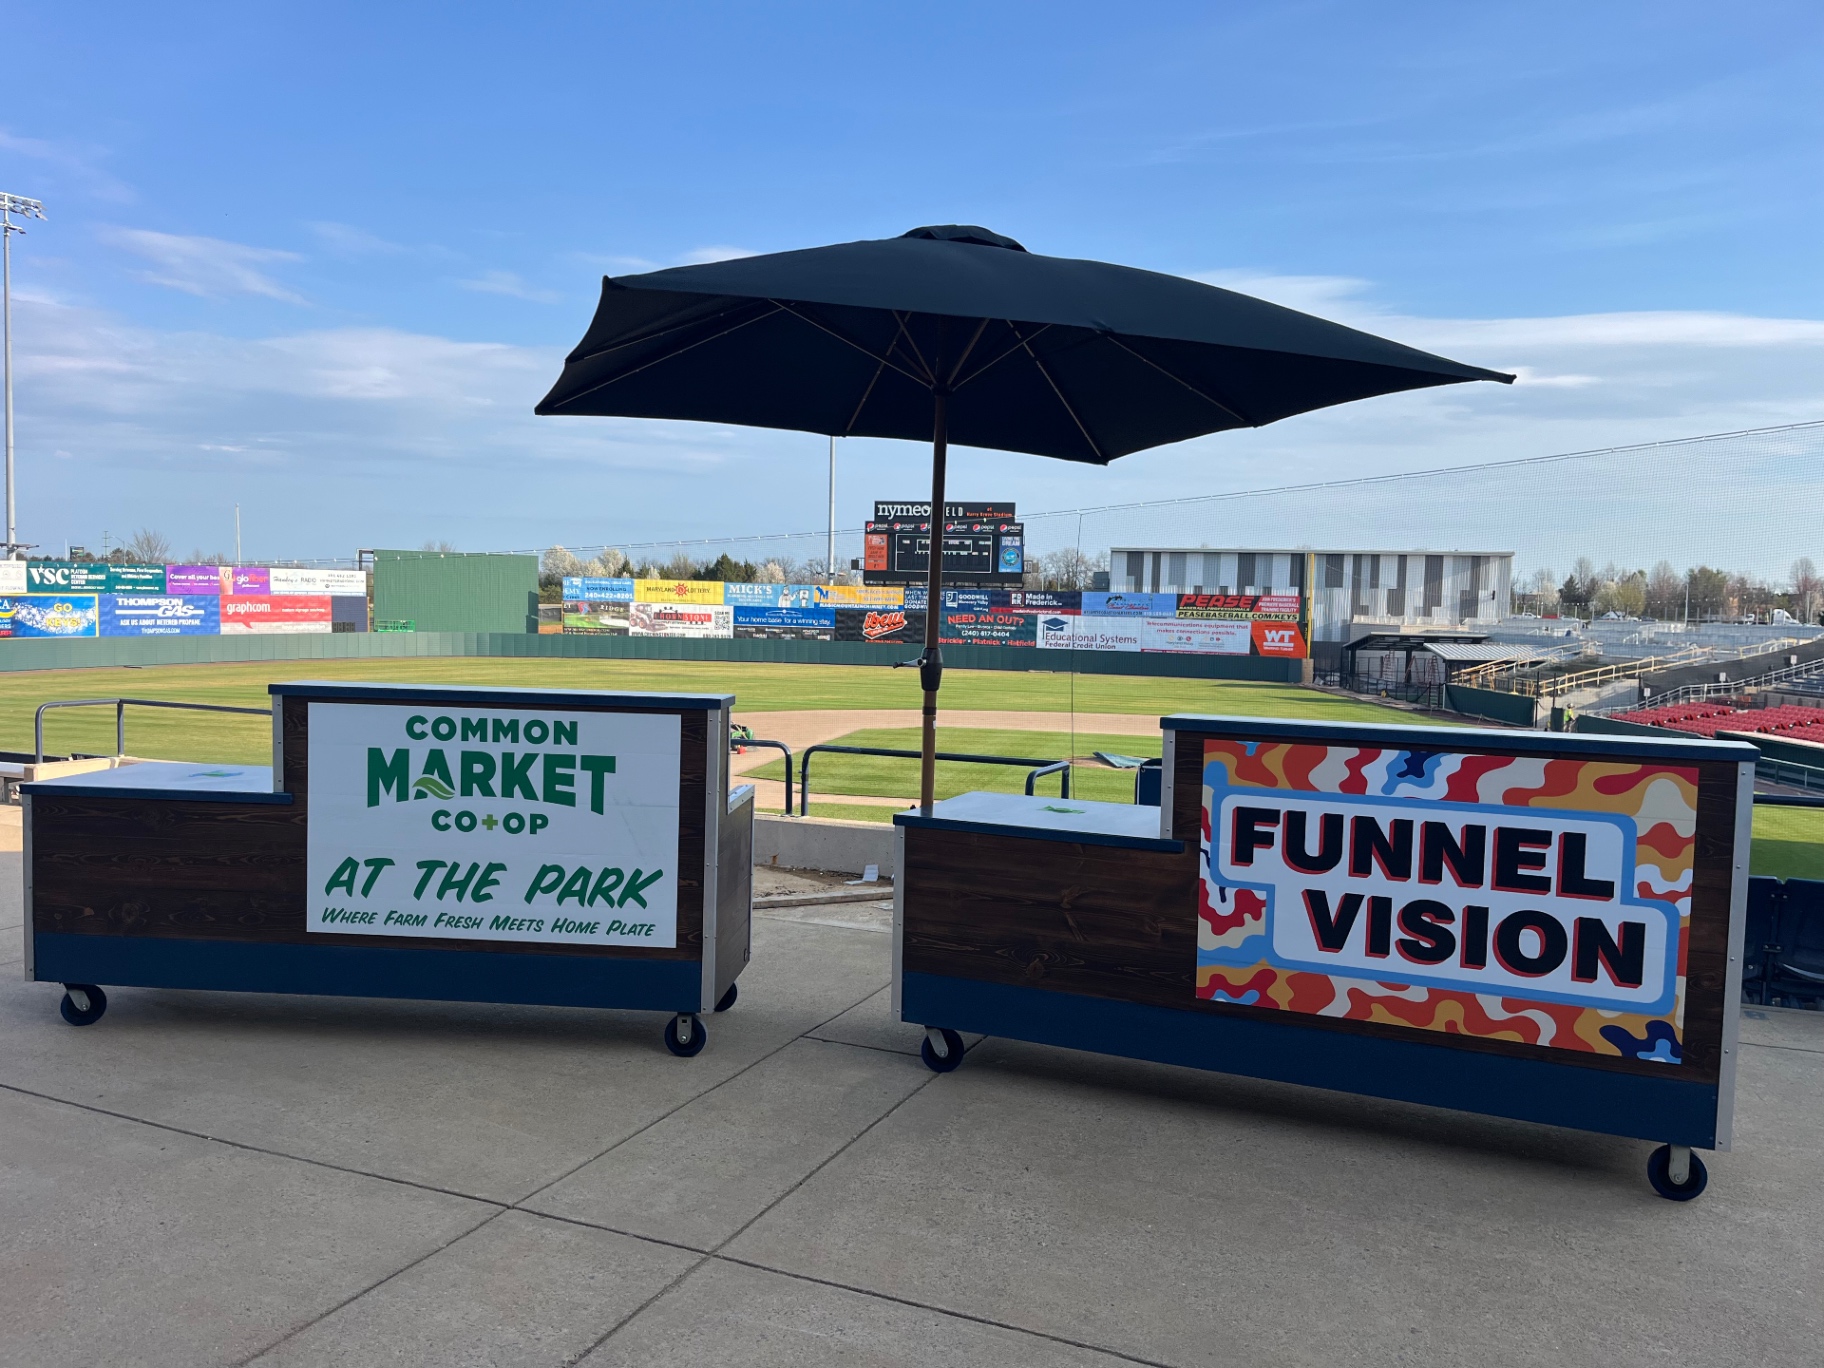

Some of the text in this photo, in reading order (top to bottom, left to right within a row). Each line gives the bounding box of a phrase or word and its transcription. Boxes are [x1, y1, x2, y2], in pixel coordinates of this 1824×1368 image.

[878, 504, 931, 520] nymeo
[28, 568, 70, 584] VSC
[729, 584, 772, 594] MICK'S
[1180, 594, 1256, 607] PEASE
[54, 603, 72, 612] GO
[158, 605, 194, 616] GAS
[226, 602, 270, 614] graphcom
[600, 604, 624, 612] RIDGE
[798, 618, 818, 626] winning
[948, 614, 1025, 626] NEED AN OUT?
[1178, 612, 1298, 620] PEASEBASEBALL.COM/KEYS
[46, 618, 82, 627] KEYS!
[1045, 632, 1138, 644] Educational Systems
[1264, 630, 1294, 642] WT
[405, 715, 578, 746] COMMON
[367, 747, 616, 816] MARKET
[1230, 806, 1615, 902] FUNNEL
[324, 856, 664, 910] AT THE PARK
[321, 907, 656, 938] WHERE FARM FRESH MEETS HOME PLATE
[1301, 888, 1646, 989] VISION
